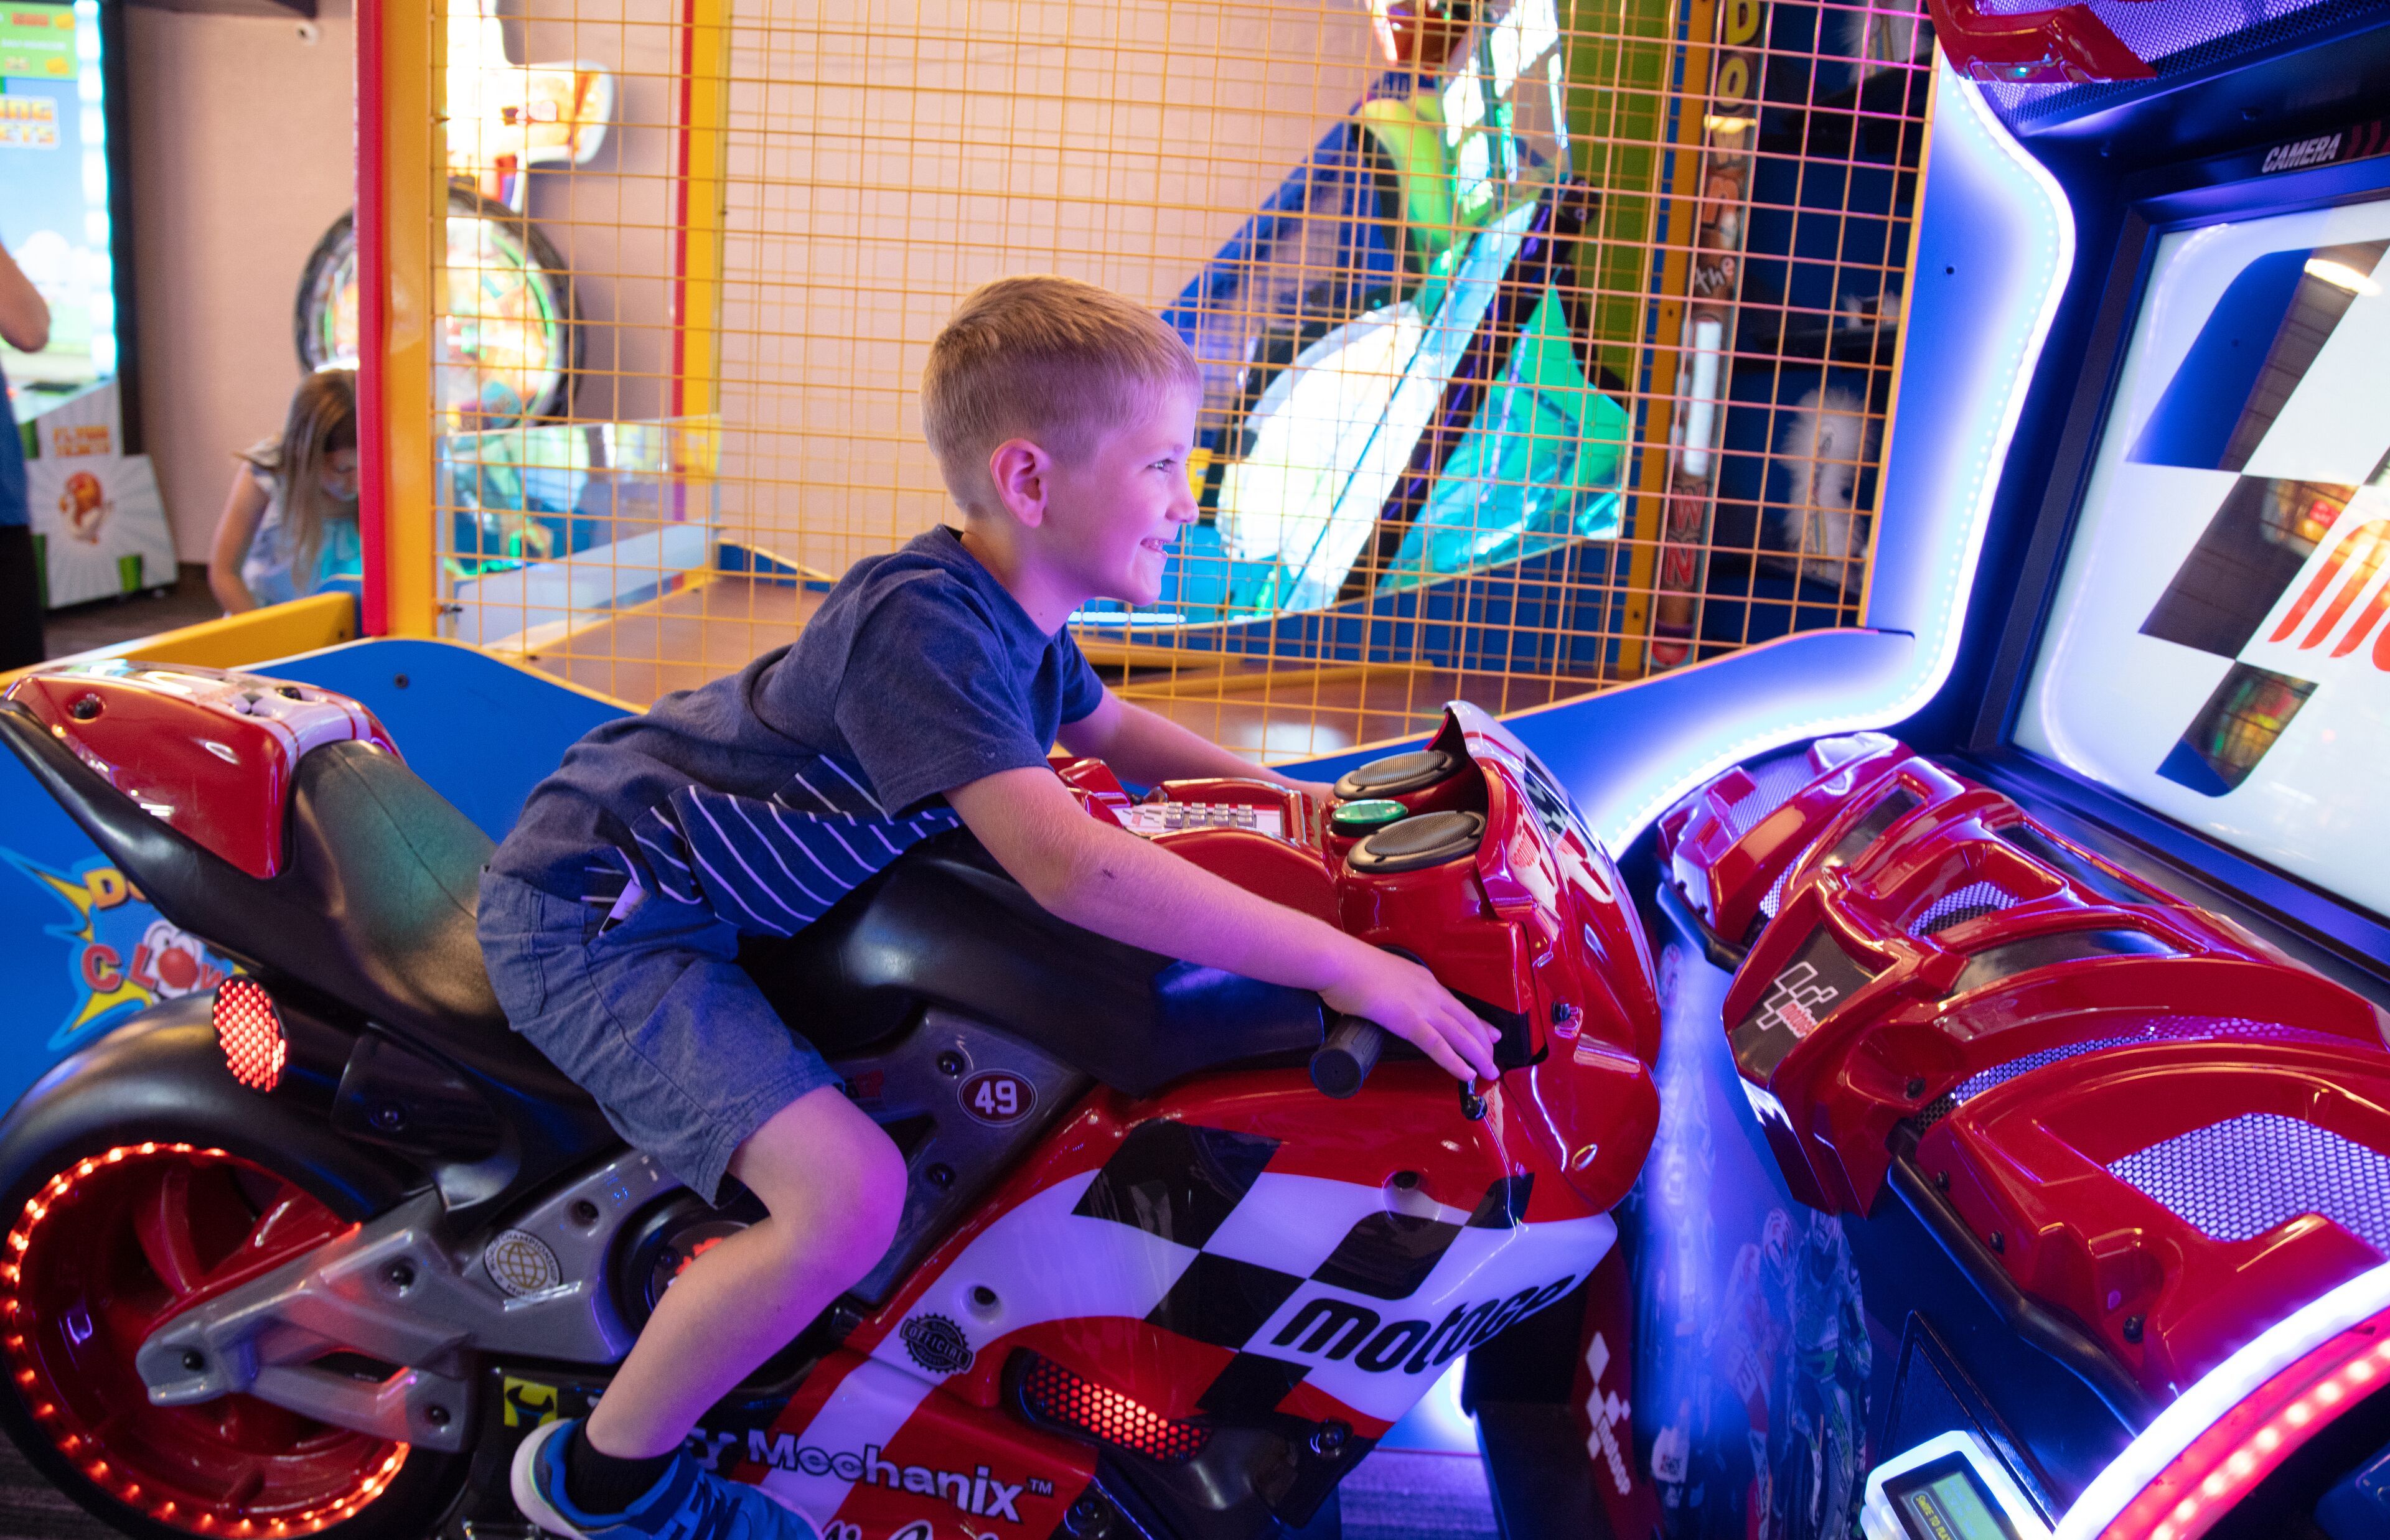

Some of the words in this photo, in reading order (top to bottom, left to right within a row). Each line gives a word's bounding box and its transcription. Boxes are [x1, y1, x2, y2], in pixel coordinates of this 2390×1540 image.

[2262, 133, 2342, 174] CAMERA
[1695, 256, 1735, 295] the
[975, 1080, 1018, 1115] 49
[907, 1325, 964, 1365] OFFICIAL
